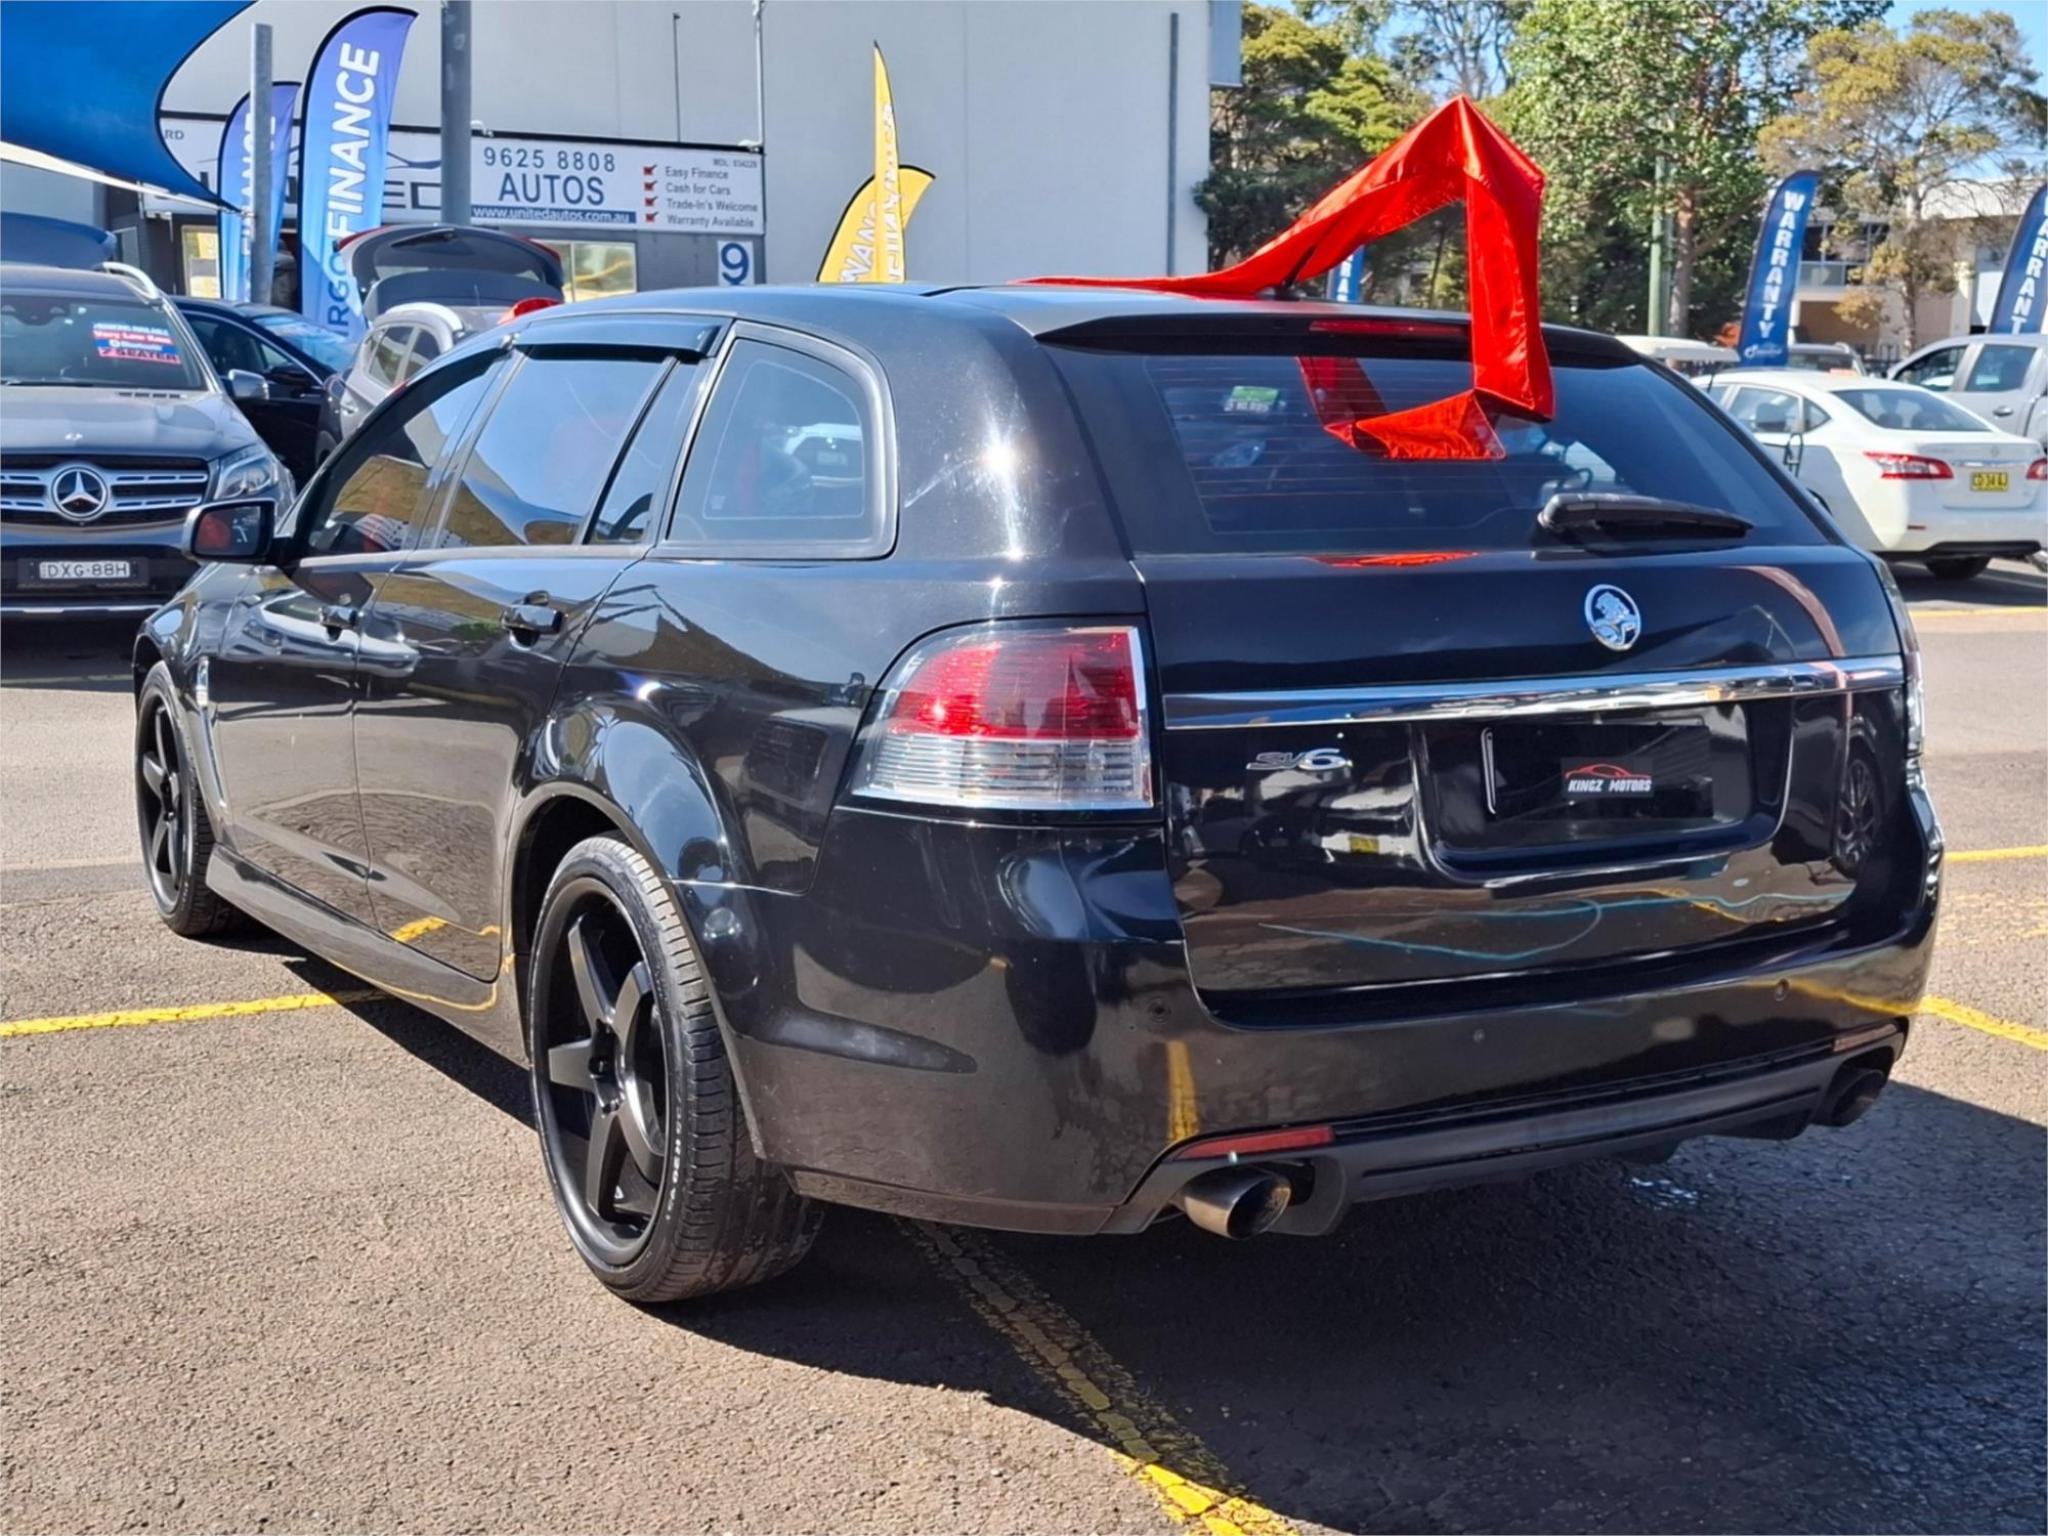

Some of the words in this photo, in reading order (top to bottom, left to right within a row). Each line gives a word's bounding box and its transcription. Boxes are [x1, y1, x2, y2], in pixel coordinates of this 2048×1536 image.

[326, 42, 380, 242] FINANCE
[483, 146, 545, 170] 9625
[557, 150, 616, 173] 8808
[665, 166, 689, 180] Easy
[691, 167, 729, 179] Finance
[499, 172, 605, 206] AUTOS
[665, 182, 690, 194] Cash
[693, 183, 707, 194] for
[708, 184, 731, 196] Cars
[471, 204, 631, 224] www.unitedautos.com.au
[715, 200, 758, 213] Welcome
[666, 214, 710, 228] Warranty
[712, 216, 755, 228] Available
[1758, 190, 1806, 339] WARRANTY
[2010, 195, 2048, 335] ARRANT
[1245, 747, 1347, 771] SV6
[1609, 779, 1652, 792] MOTORS
